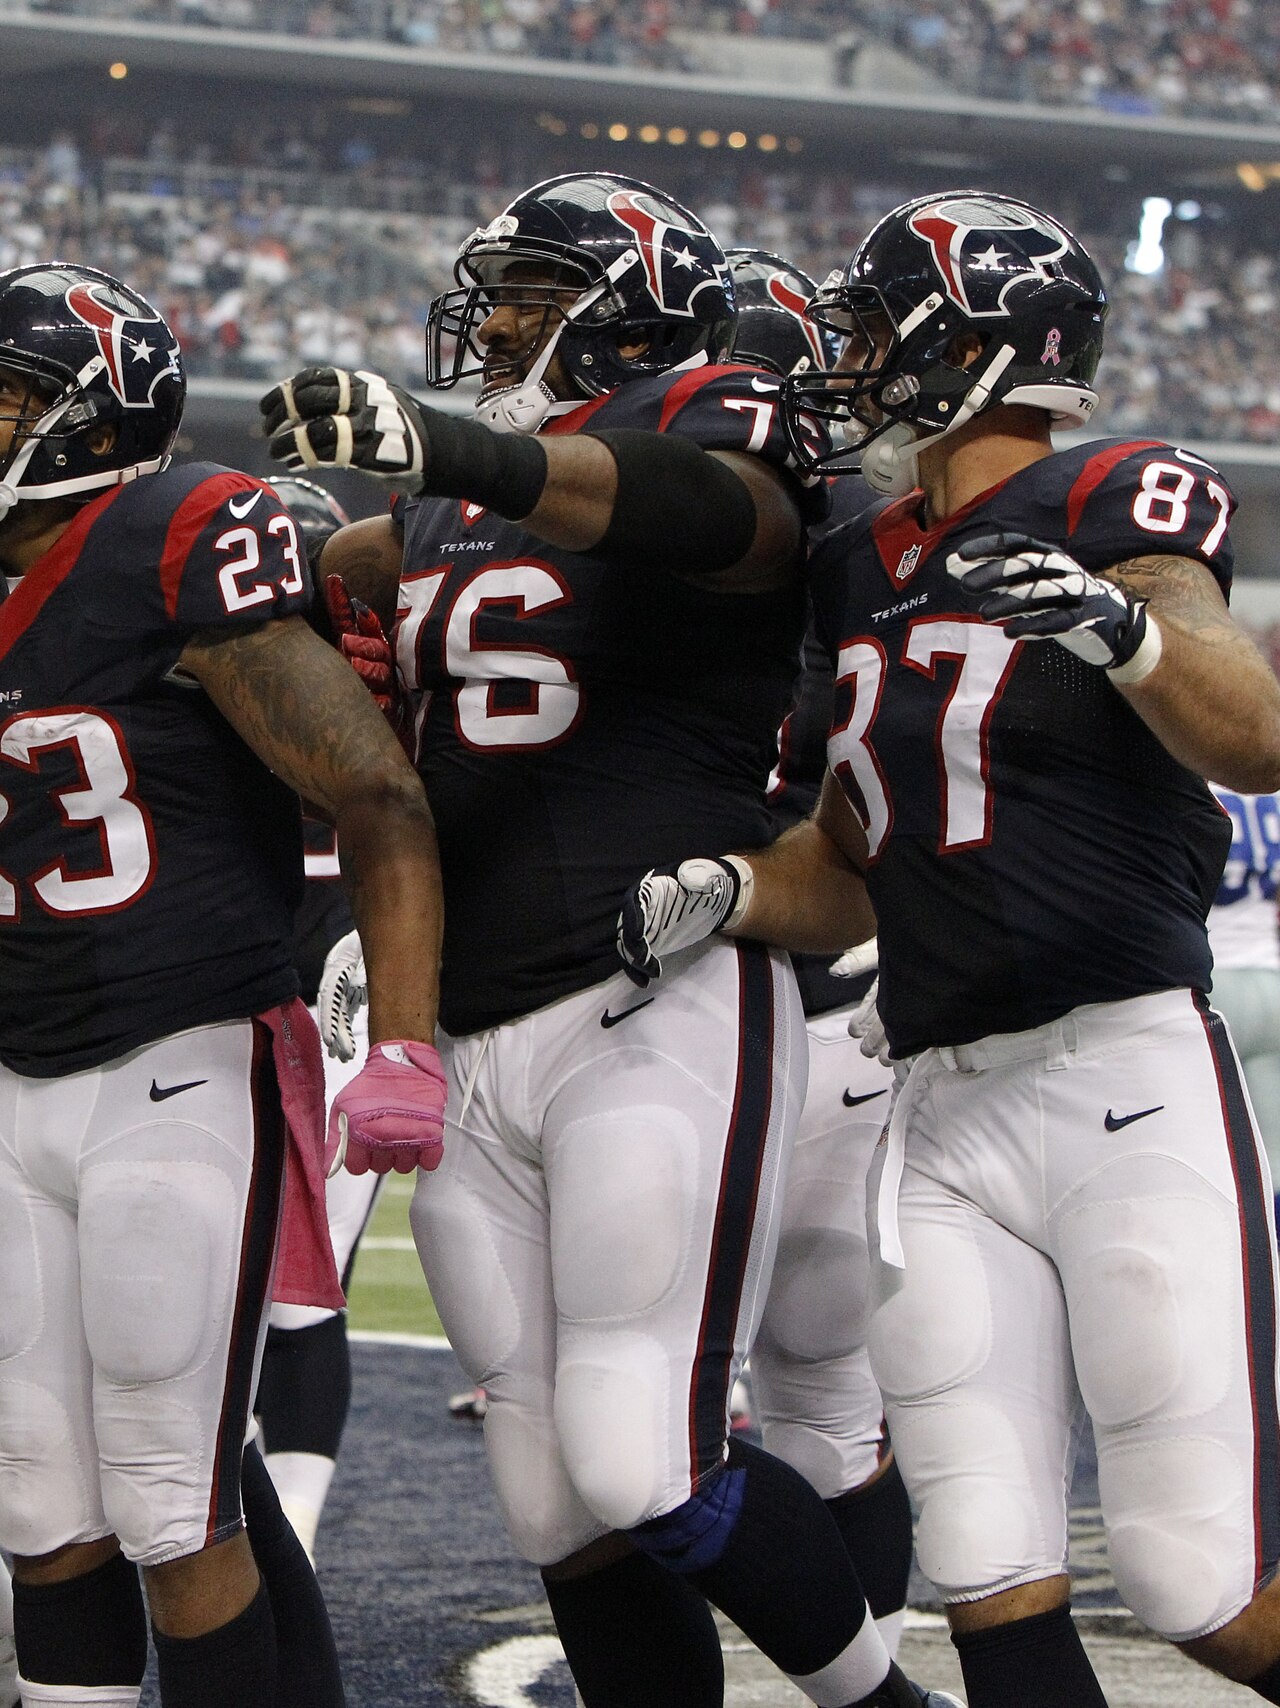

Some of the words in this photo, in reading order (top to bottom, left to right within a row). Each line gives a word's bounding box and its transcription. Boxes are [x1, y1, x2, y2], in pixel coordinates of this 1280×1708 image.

[1129, 459, 1232, 560] 87
[212, 512, 304, 616] 23
[439, 541, 496, 554] TEXANS
[870, 592, 928, 623] TEXANS
